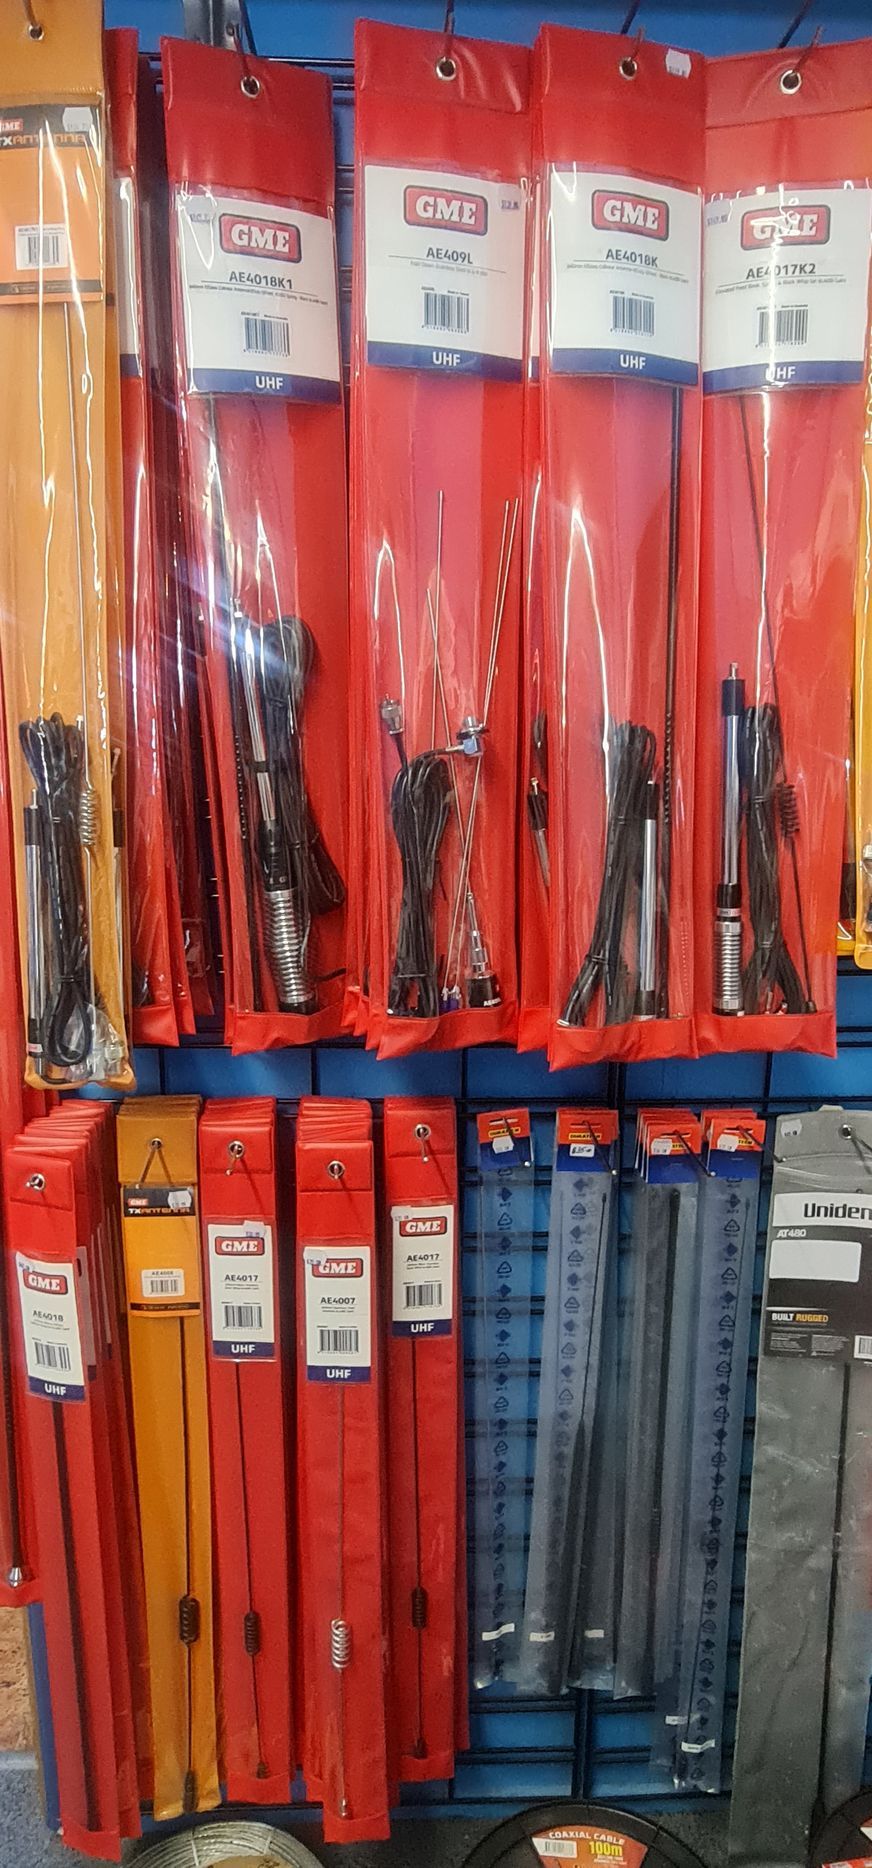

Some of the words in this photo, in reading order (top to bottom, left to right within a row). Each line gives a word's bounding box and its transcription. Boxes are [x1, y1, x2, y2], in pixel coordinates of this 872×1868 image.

[415, 195, 477, 225] GME
[603, 199, 659, 230] GME
[231, 223, 290, 253] GME
[426, 247, 473, 265] AE409L
[605, 248, 659, 268] AE4018K
[229, 271, 294, 290] AE4018K1
[432, 351, 461, 367] UHF
[619, 354, 646, 370] UHF
[765, 365, 796, 381] UHF
[255, 375, 284, 390] UHF
[803, 1202, 872, 1221] Uniden
[405, 1220, 441, 1233] GME
[776, 1228, 807, 1239] AT480
[221, 1240, 258, 1252] GME
[406, 1253, 440, 1262] AE4017
[319, 1262, 357, 1274] GME
[27, 1274, 61, 1291] GME
[224, 1274, 259, 1282] AE4017
[320, 1297, 356, 1305] AE4007
[32, 1309, 64, 1322] AE4018
[771, 1312, 795, 1321] BUILT
[795, 1313, 829, 1323] RUGGED
[410, 1323, 435, 1333] UHF
[231, 1344, 256, 1354] UHF
[326, 1369, 352, 1379] UHF
[44, 1383, 67, 1396] UHF
[548, 1831, 592, 1839] COAXIAL
[593, 1833, 626, 1846] CABLE
[589, 1841, 623, 1857] 100m
